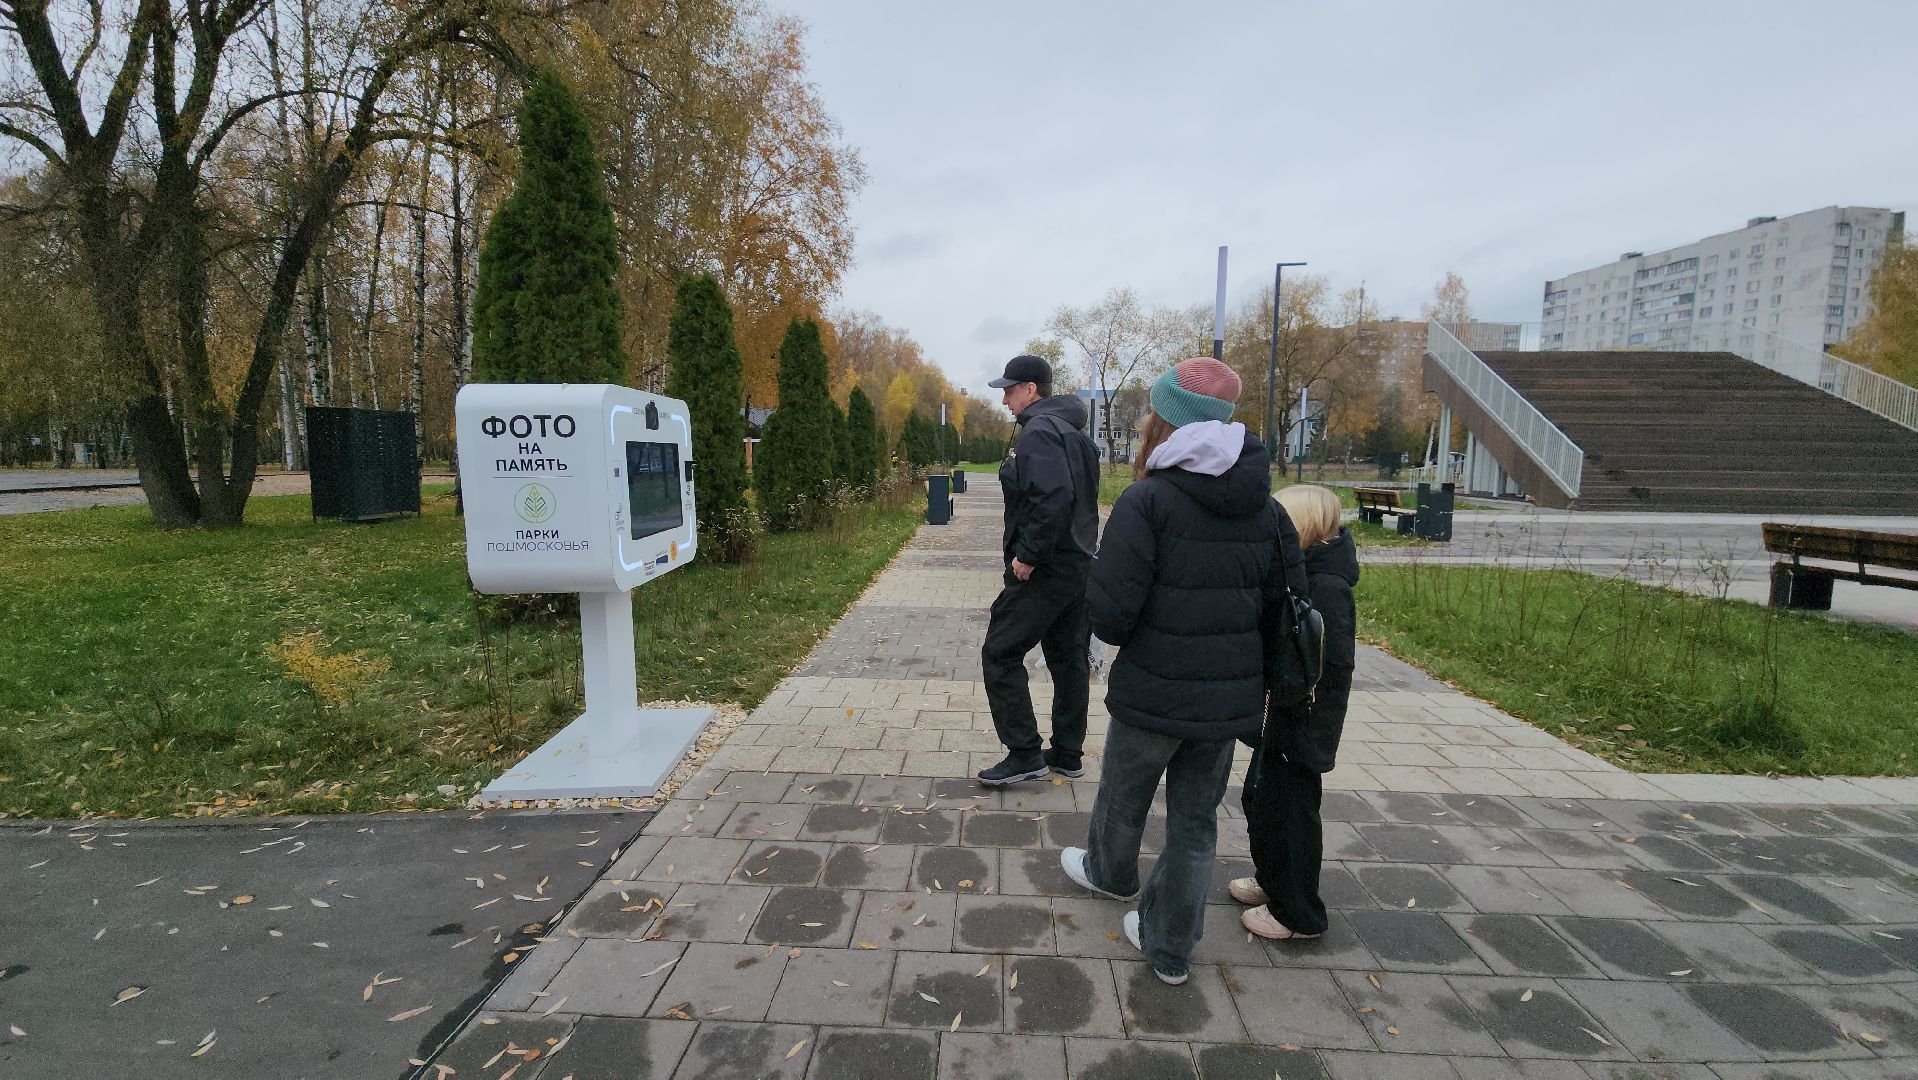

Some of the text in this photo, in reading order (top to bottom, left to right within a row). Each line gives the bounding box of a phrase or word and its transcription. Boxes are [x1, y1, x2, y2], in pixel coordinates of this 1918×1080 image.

[481, 414, 576, 439] ФОТО
[518, 442, 543, 455] НА
[495, 458, 568, 472] ПАМЯТЬ
[516, 529, 560, 540] ПАРКИ
[487, 540, 589, 552] ПОДМОСКОВЬЯ
